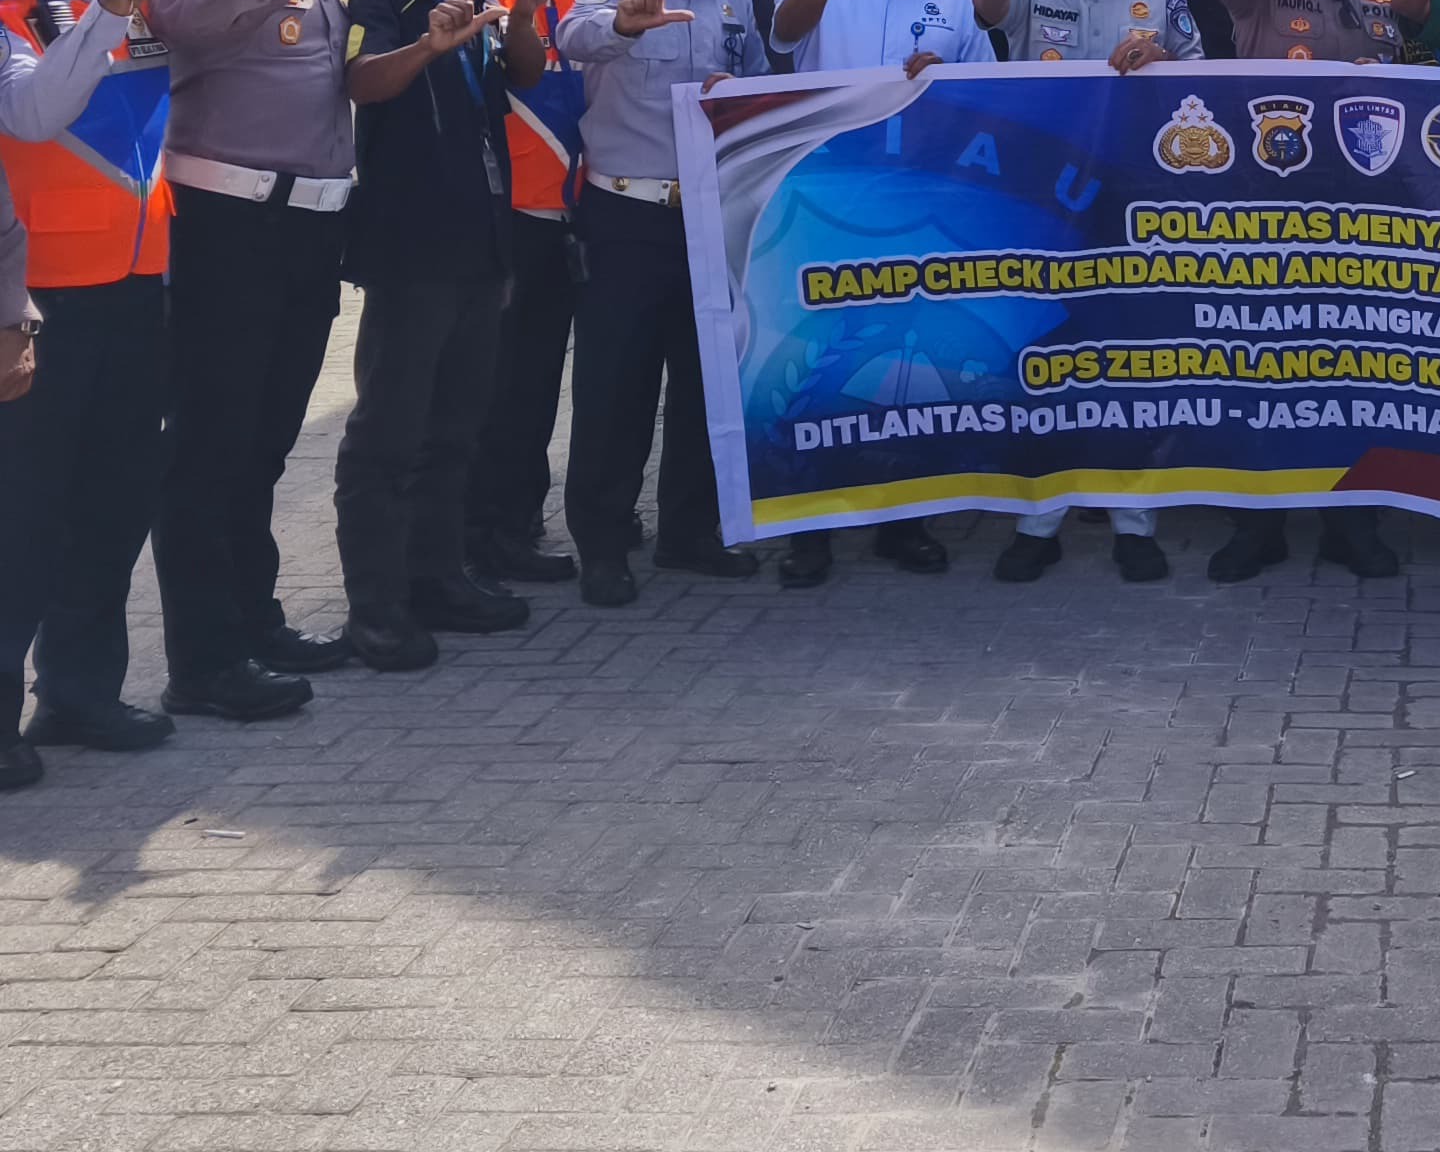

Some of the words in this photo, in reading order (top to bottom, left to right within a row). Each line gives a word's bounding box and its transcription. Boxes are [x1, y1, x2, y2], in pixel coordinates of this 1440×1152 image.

[1033, 3, 1080, 23] HIDAYAT
[1344, 104, 1364, 114] LALU
[1136, 211, 1332, 239] POLANTAS
[807, 265, 918, 301] RAMP
[923, 259, 1044, 290] CHECK
[1049, 255, 1278, 290] KENDARAAN
[1194, 303, 1311, 331] DALAM
[1026, 350, 1101, 386] OPS
[1106, 348, 1230, 378] ZEBRA
[1235, 350, 1412, 381] LANCANG
[794, 403, 1004, 450] DITLANTAS
[1011, 401, 1128, 435] POLDA
[1133, 398, 1221, 429] RIAU
[1247, 399, 1346, 430] JASA
